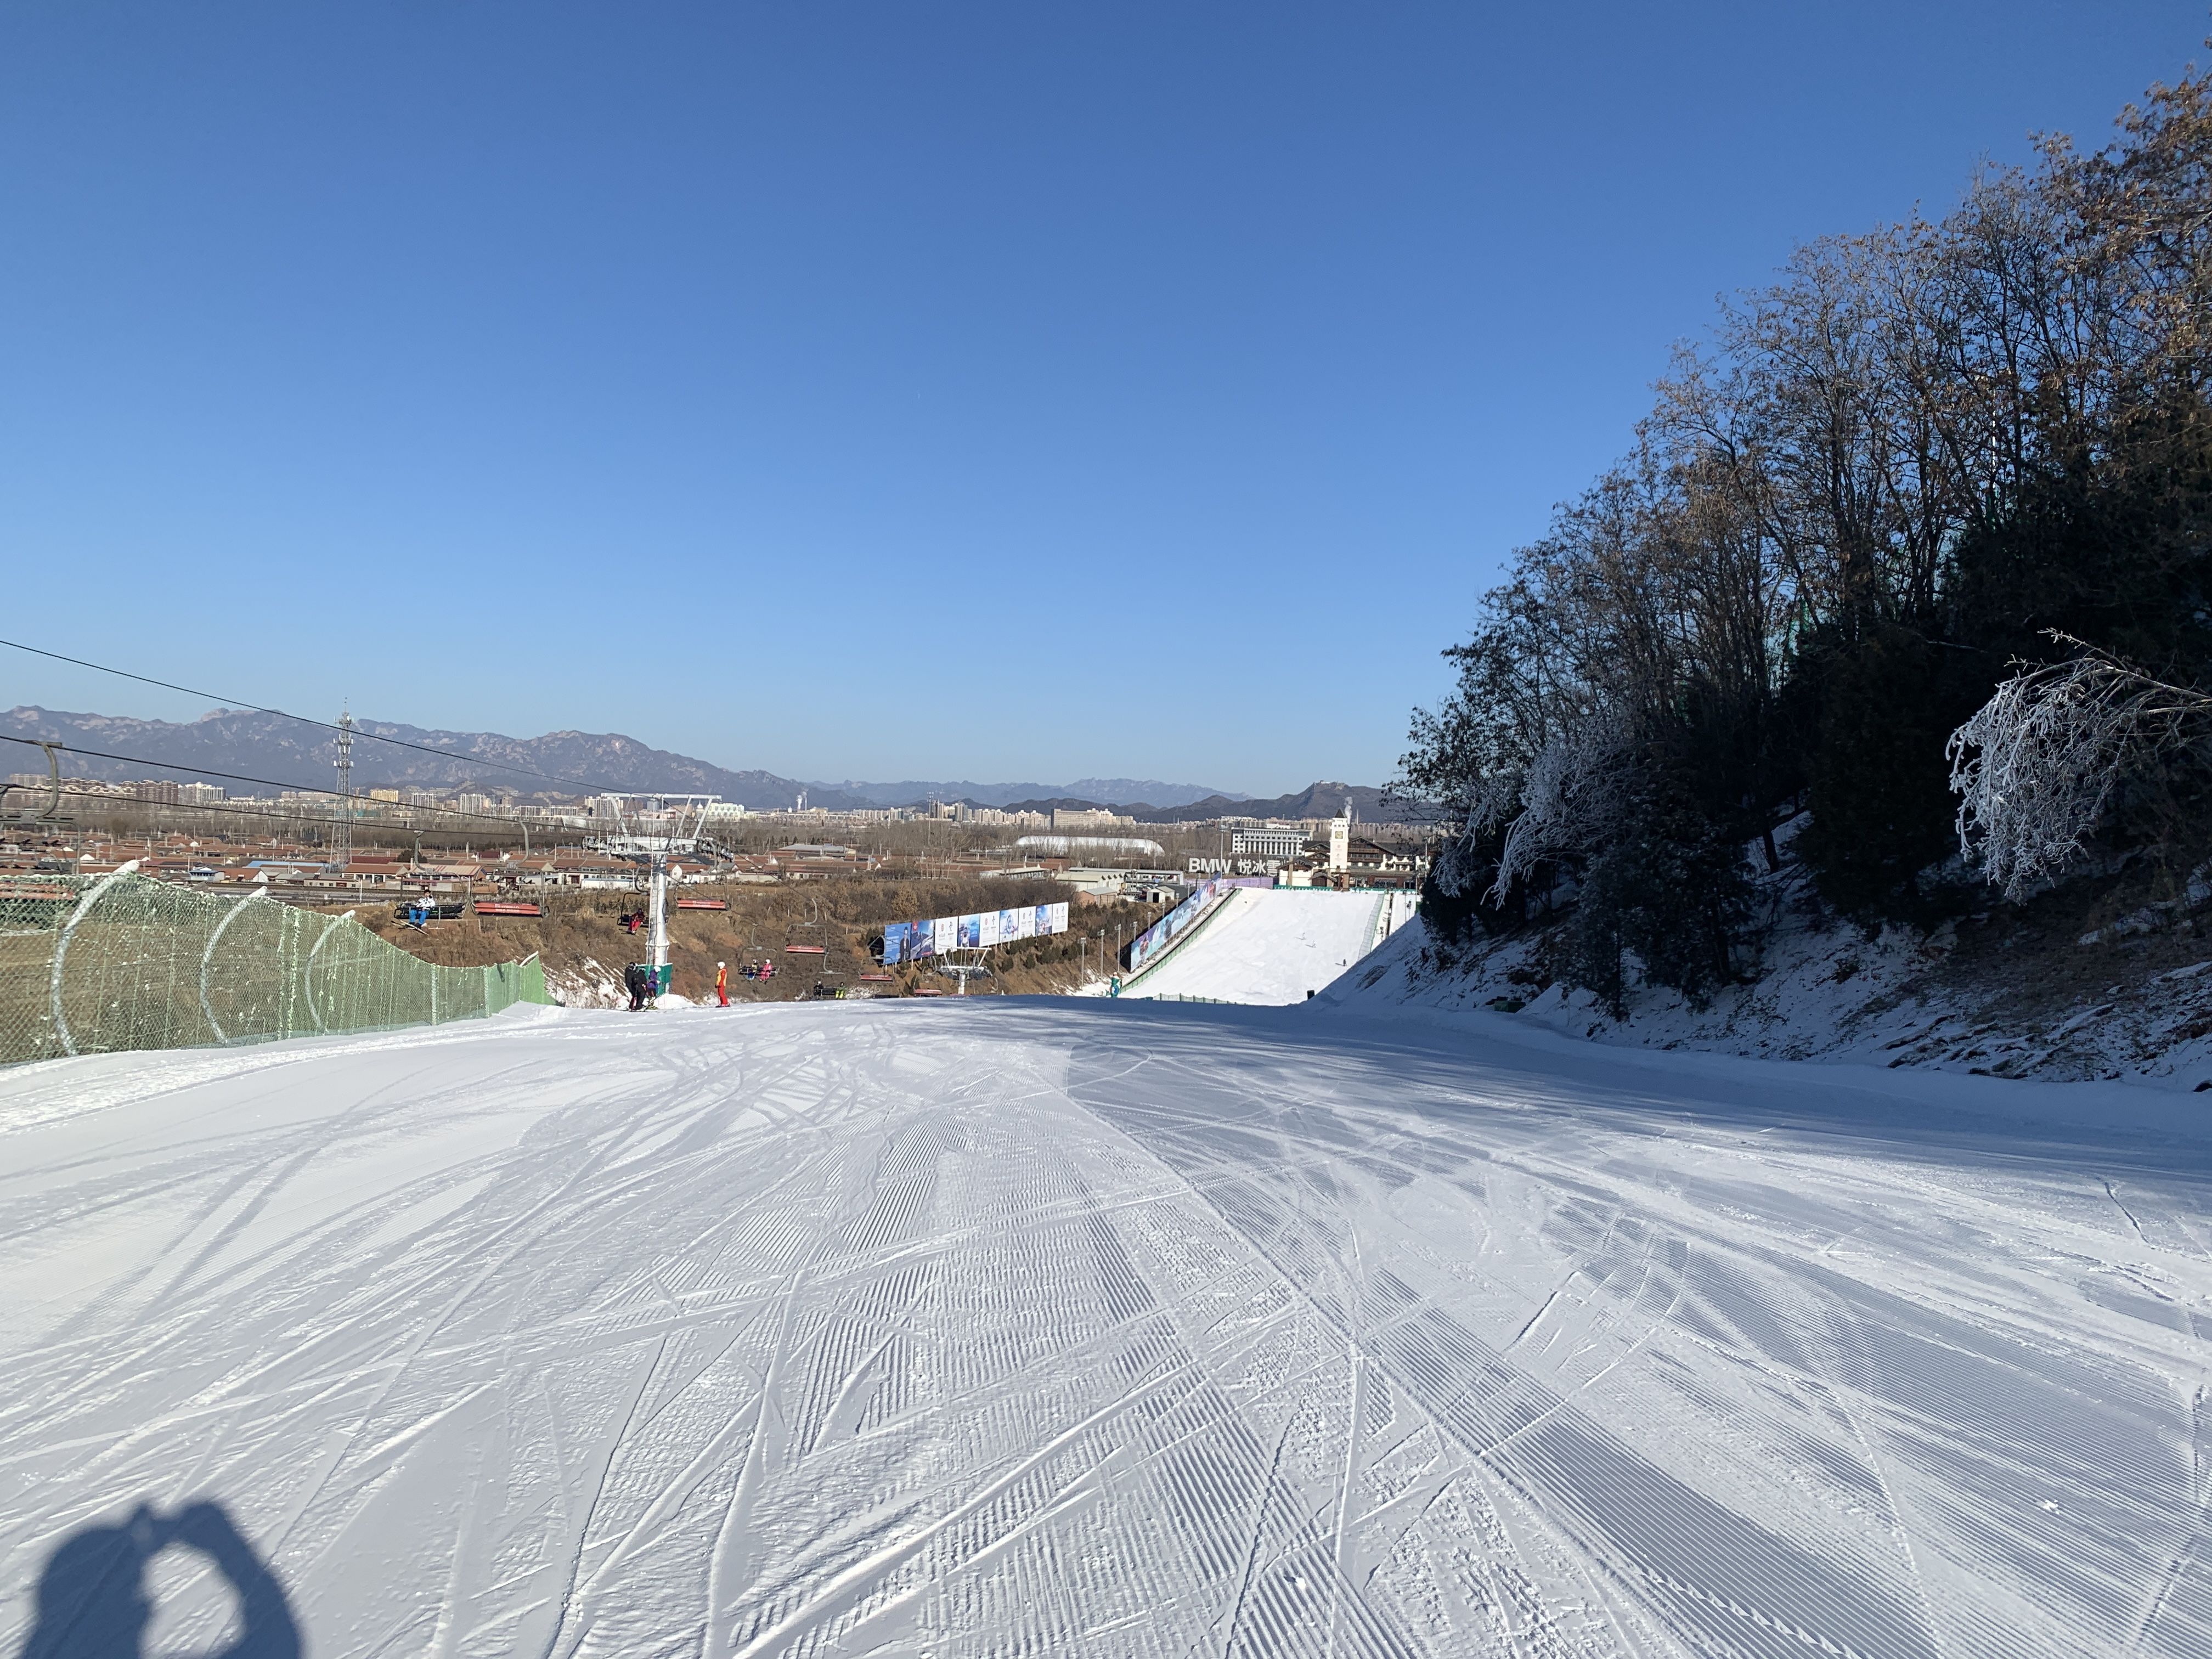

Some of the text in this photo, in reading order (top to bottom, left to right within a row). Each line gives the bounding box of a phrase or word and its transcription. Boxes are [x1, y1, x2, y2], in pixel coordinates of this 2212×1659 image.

[1189, 857, 1289, 876] BMW 悦冰雪
